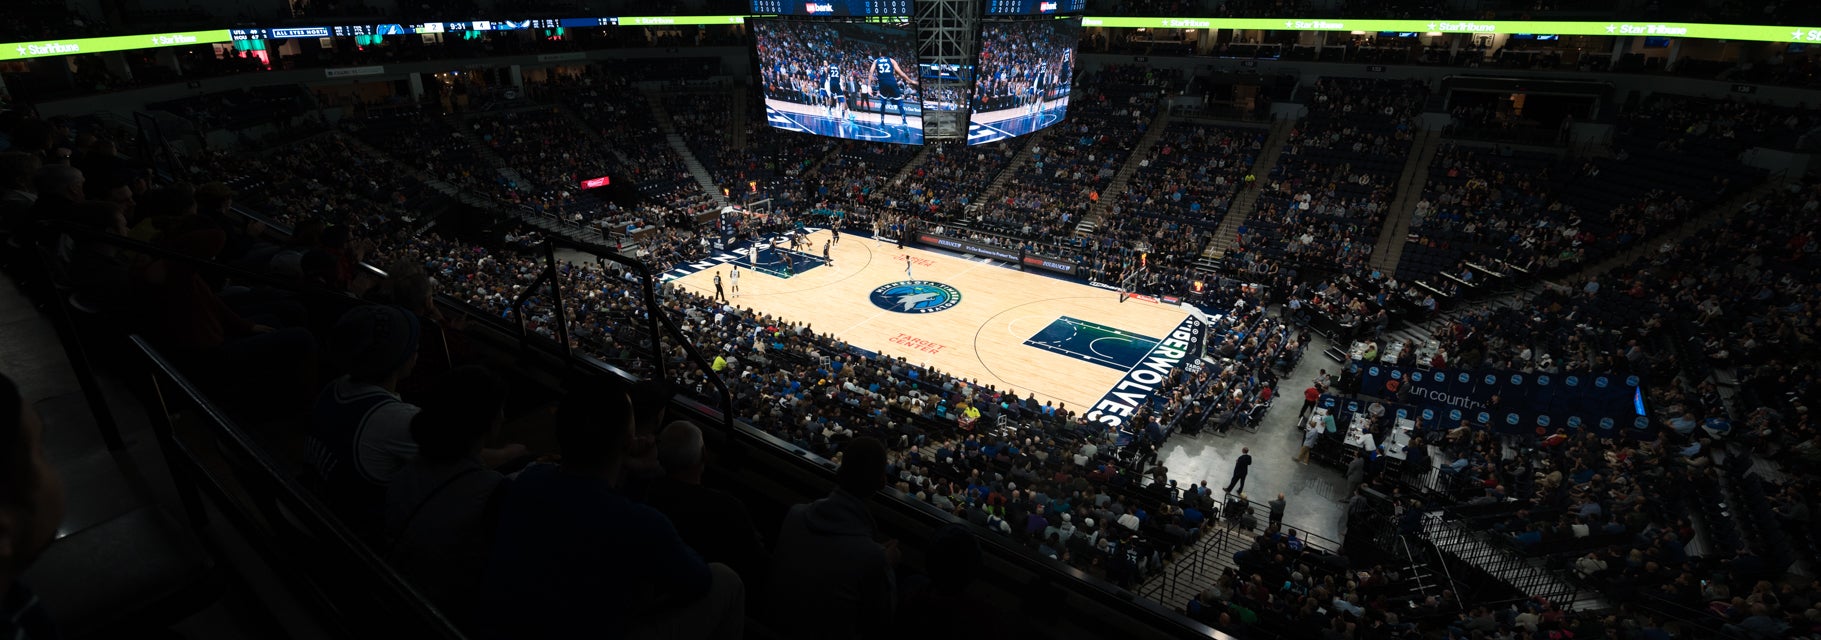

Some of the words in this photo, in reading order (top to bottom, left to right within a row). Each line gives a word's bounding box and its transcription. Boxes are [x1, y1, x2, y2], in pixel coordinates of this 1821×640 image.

[878, 64, 891, 73] 32
[889, 337, 939, 354] CENTER
[898, 333, 947, 350] TARGET
